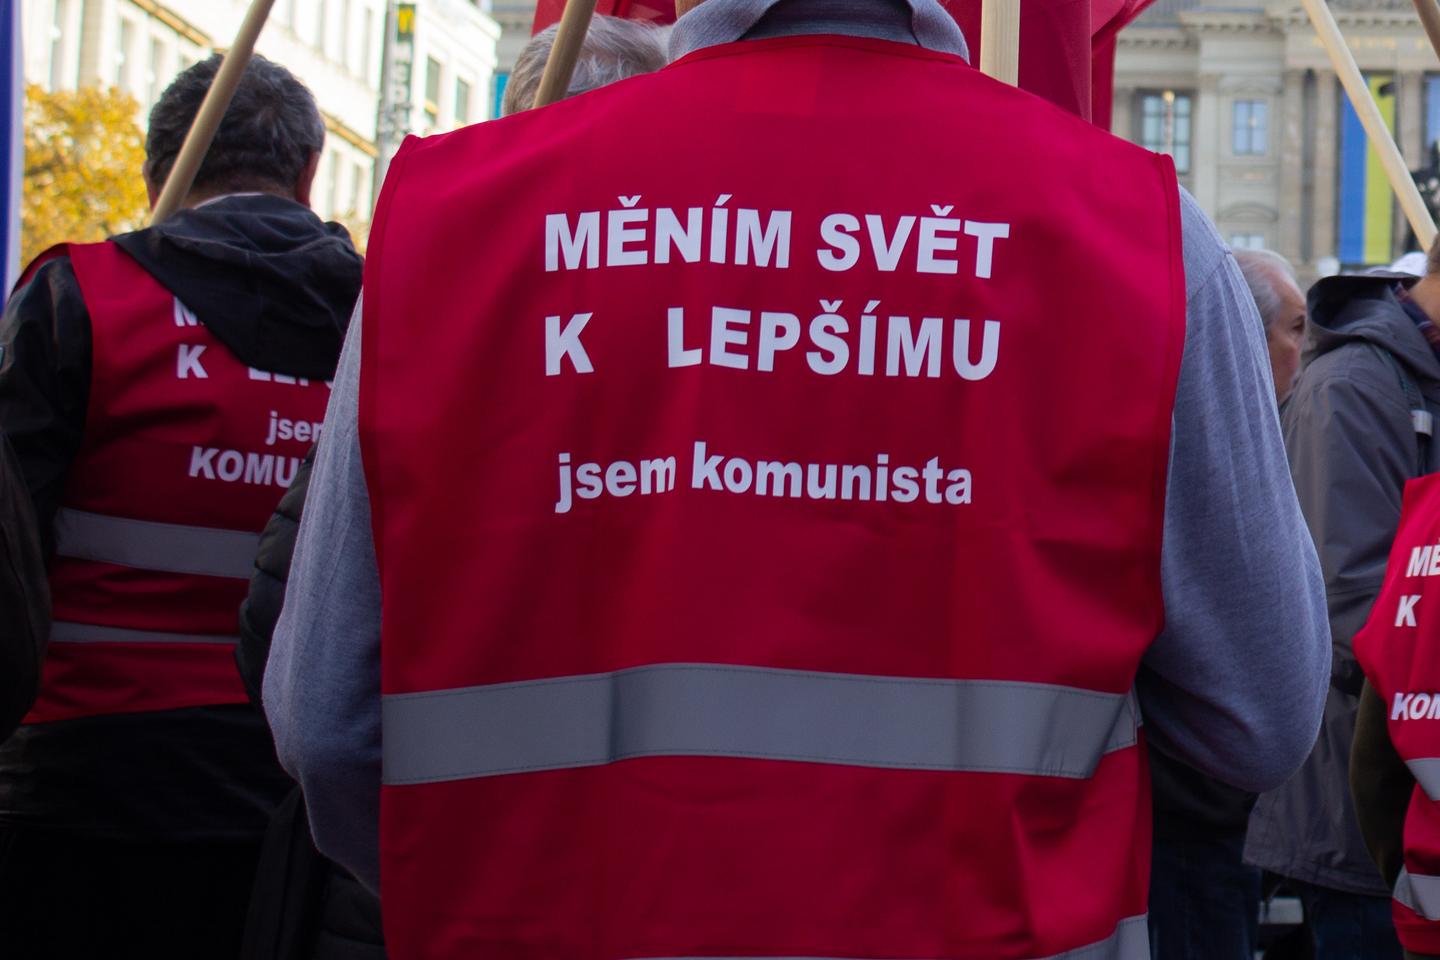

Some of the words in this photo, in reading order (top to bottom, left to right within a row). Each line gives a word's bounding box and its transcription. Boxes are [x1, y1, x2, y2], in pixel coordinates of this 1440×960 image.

[545, 194, 793, 272] MĚNÍM
[816, 204, 1011, 279] SVĚT
[176, 343, 209, 379] K
[545, 312, 595, 376] K
[667, 299, 1001, 381] LEPŠÍMU
[188, 445, 304, 489] KOMU
[554, 452, 677, 514] jsem
[691, 441, 973, 505] komunista
[1394, 594, 1422, 628] K
